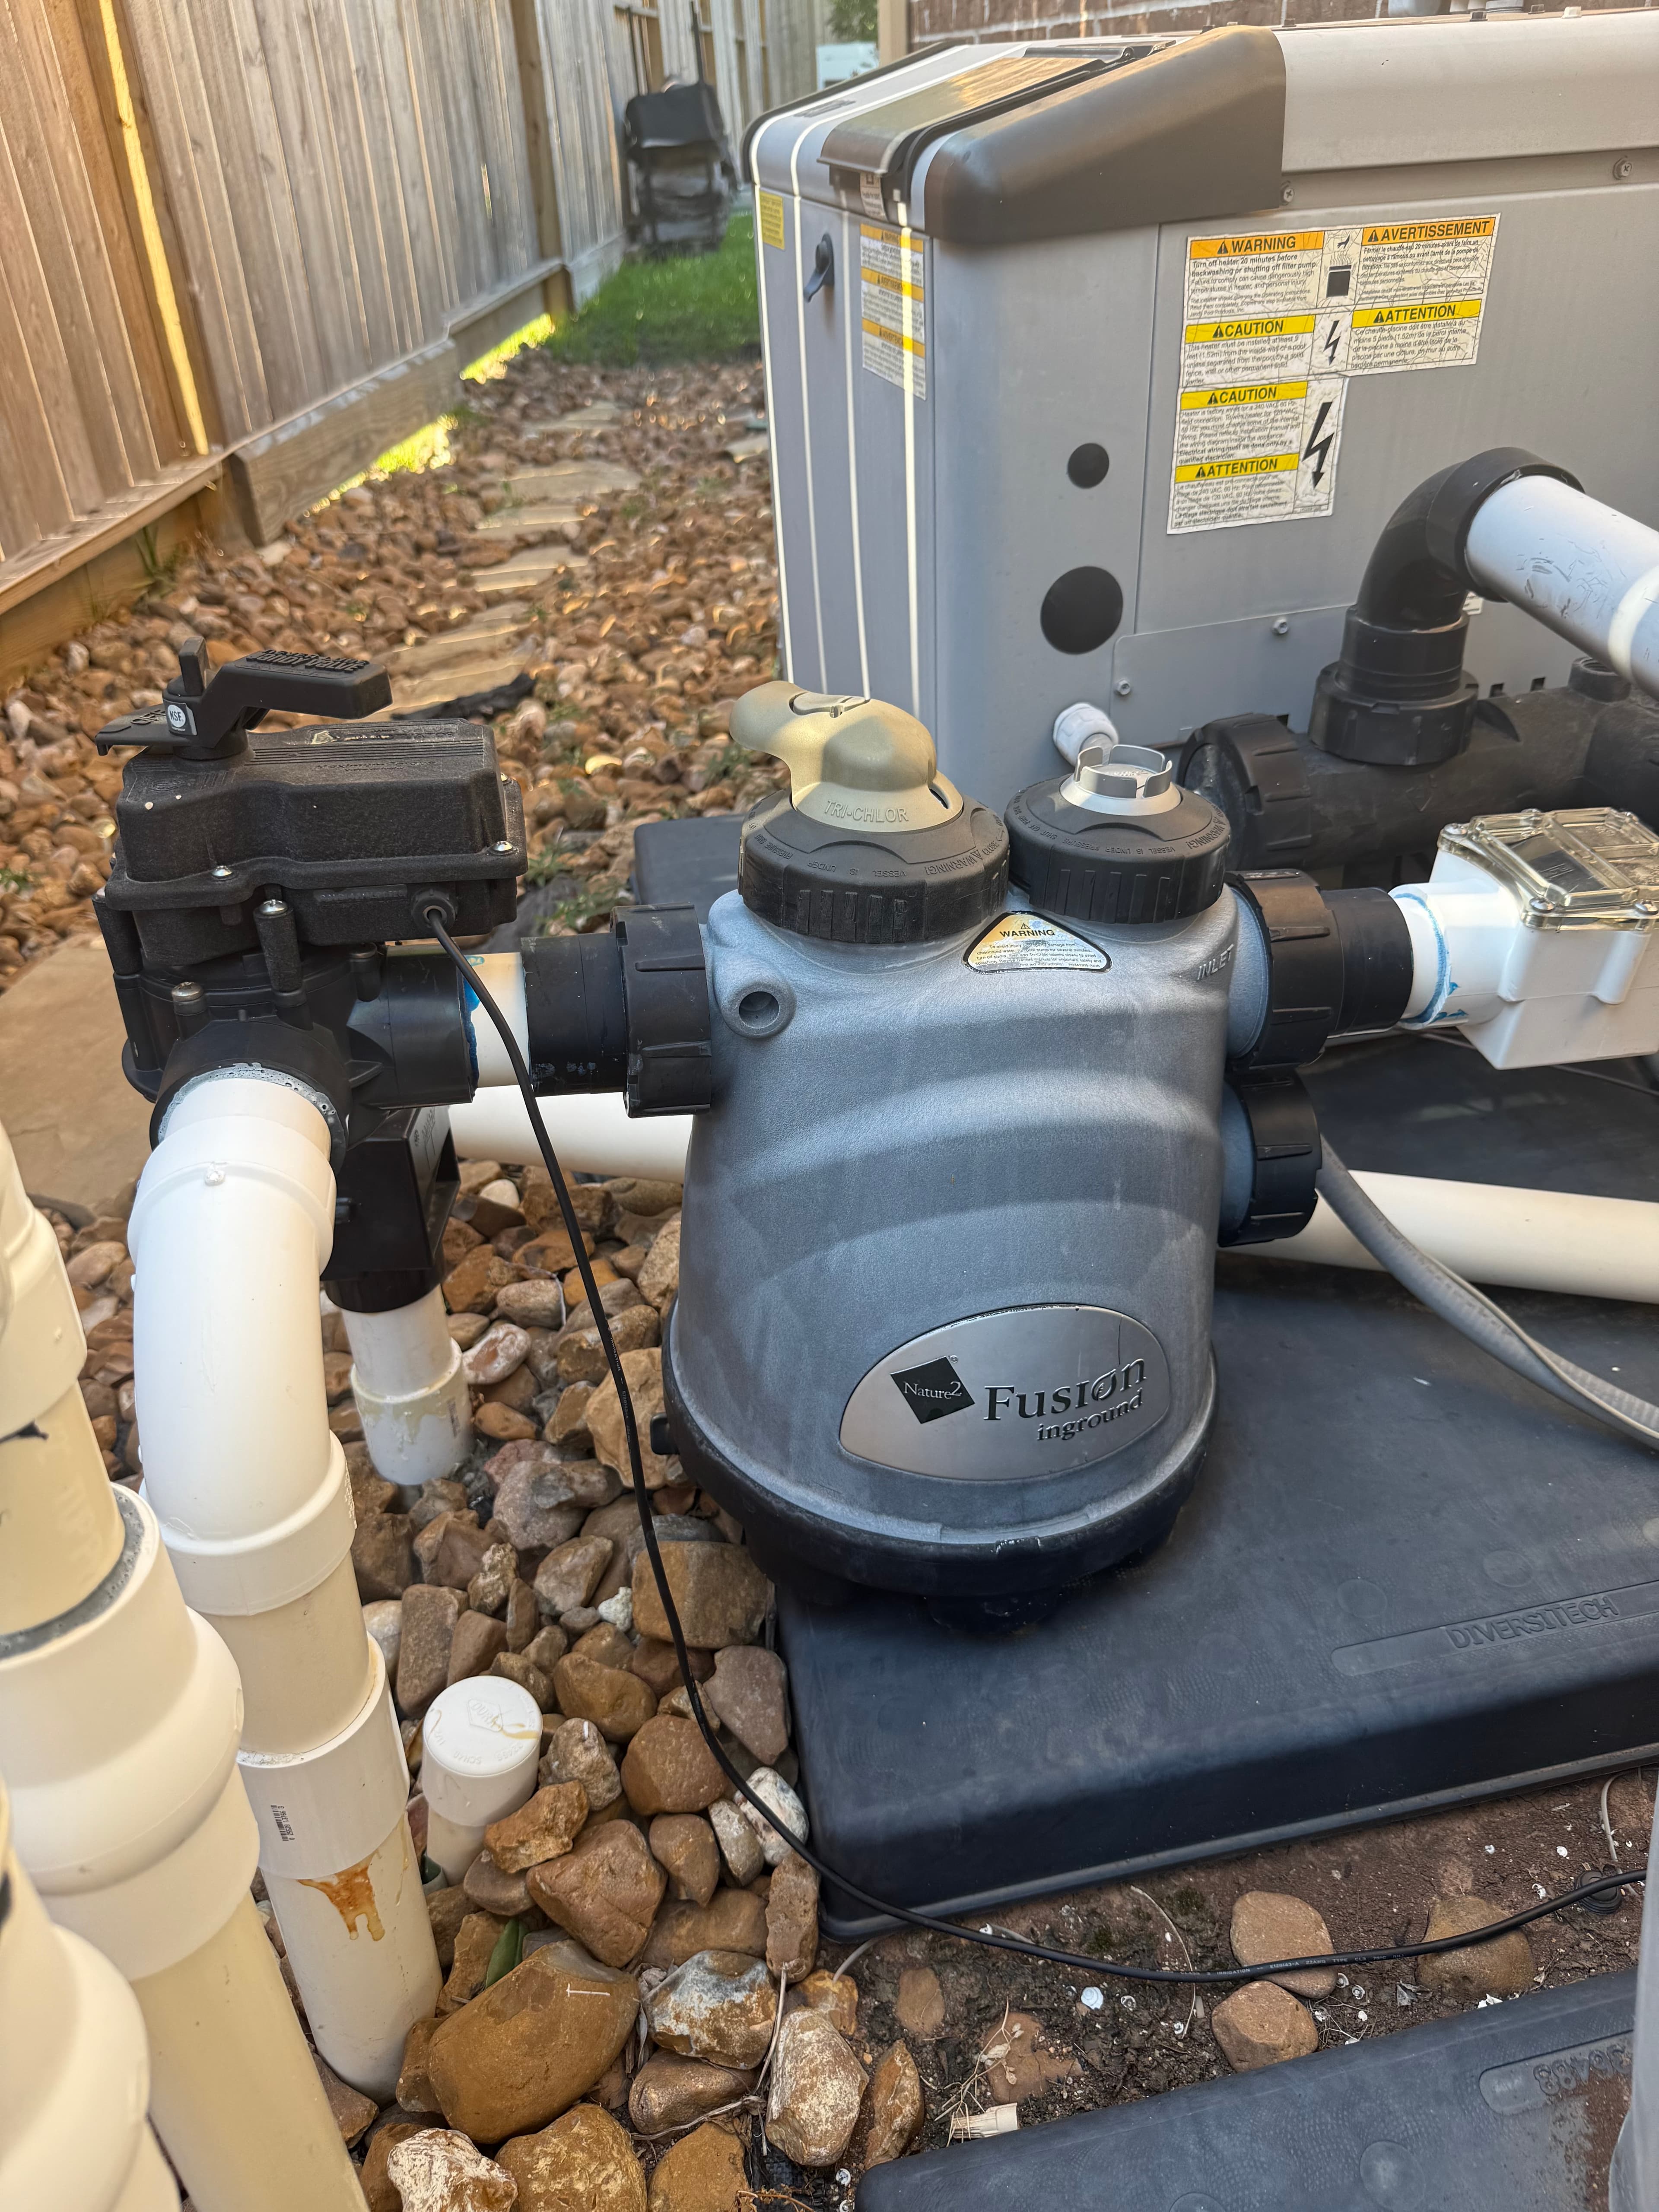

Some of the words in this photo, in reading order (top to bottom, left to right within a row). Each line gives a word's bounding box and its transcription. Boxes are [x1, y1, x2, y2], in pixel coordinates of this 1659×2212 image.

[1381, 221, 1490, 241] AVERTISSEMENT
[1232, 236, 1296, 253] WARNING
[1249, 255, 1275, 264] minutes
[1277, 254, 1297, 262] before
[1192, 268, 1233, 277] backwashing
[1243, 264, 1269, 273] shutting
[1385, 305, 1456, 322] ATTENTION
[1225, 320, 1284, 337] CAUTION
[1220, 387, 1277, 403] CAUTION
[1207, 459, 1278, 477] ATTENTION
[169, 710, 181, 721] NSF
[824, 800, 909, 823] TRI-CHLOR
[1028, 823, 1040, 832] OFF
[1040, 830, 1058, 840] SHUT
[754, 833, 767, 845] SHUT
[1062, 838, 1100, 851] PRESSURE
[1185, 825, 1225, 849] WARNING!
[764, 842, 793, 860] PRESSURE
[807, 860, 836, 873] UNDER
[925, 855, 976, 875] WARNING!
[1196, 944, 1234, 982] INLET
[983, 1358, 1147, 1421] Fusion
[1037, 1388, 1143, 1441] inground
[1446, 1597, 1619, 1648] DIVERSITECH
